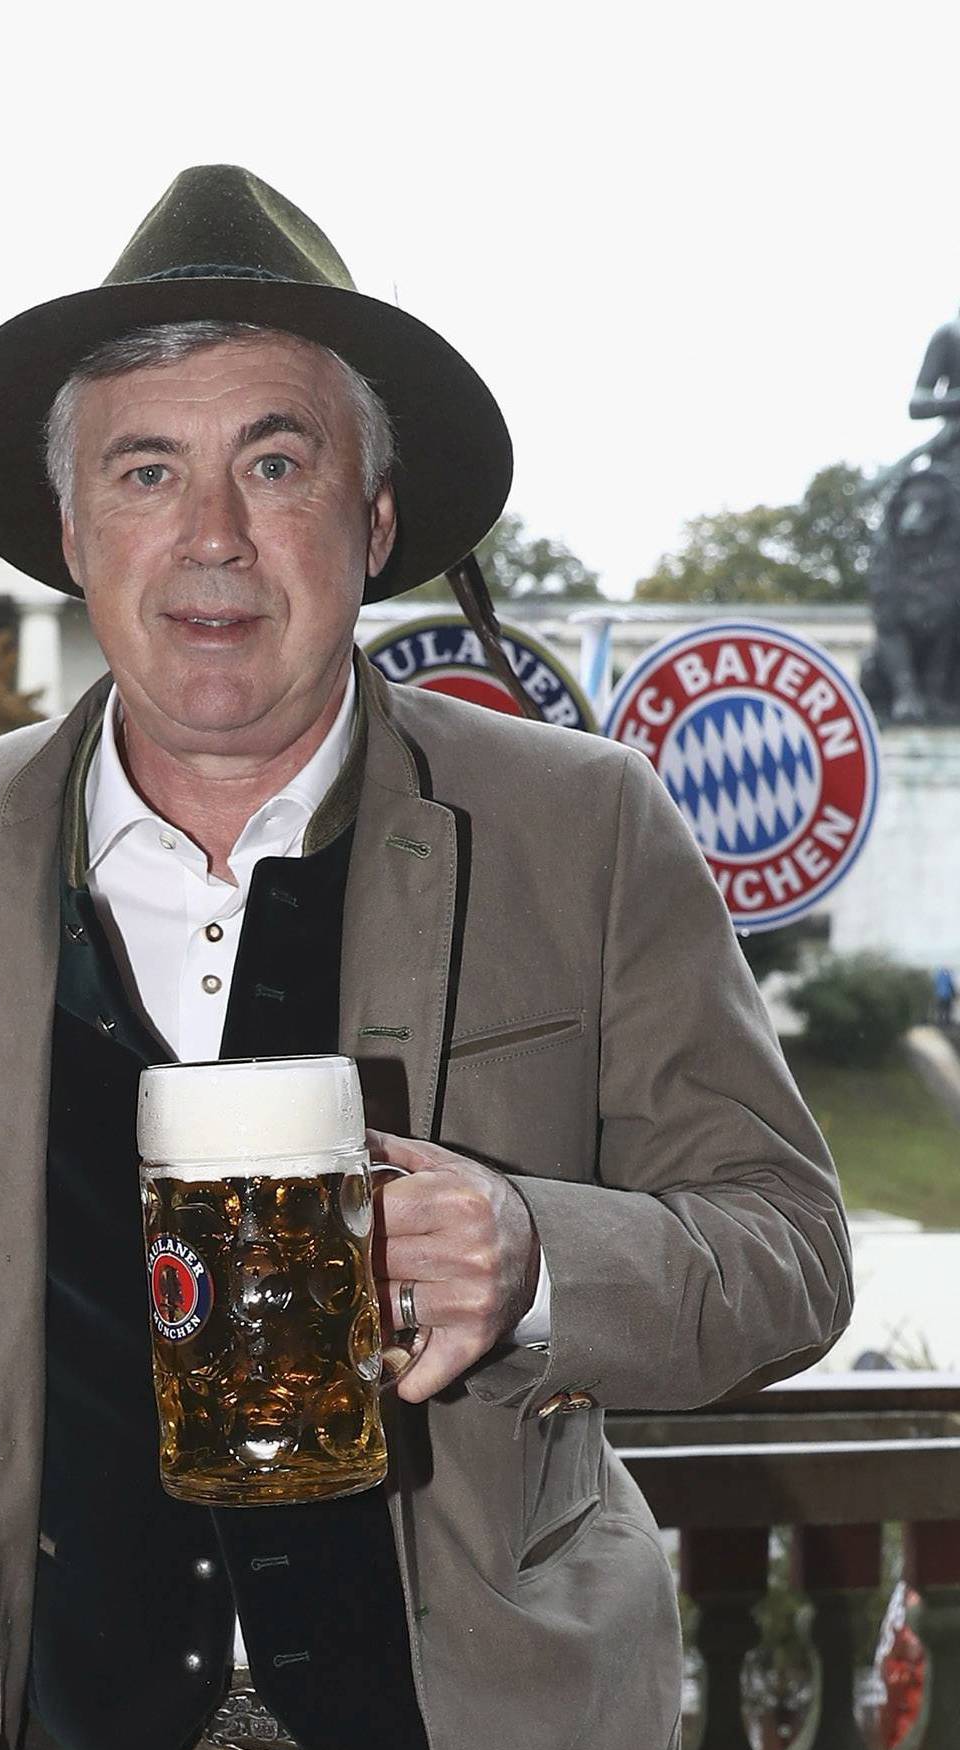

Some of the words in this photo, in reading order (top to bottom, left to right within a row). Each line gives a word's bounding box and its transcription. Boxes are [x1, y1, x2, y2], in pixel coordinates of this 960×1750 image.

[375, 629, 581, 728] ULANER
[623, 686, 676, 756] FC
[672, 643, 857, 760] BAYERN
